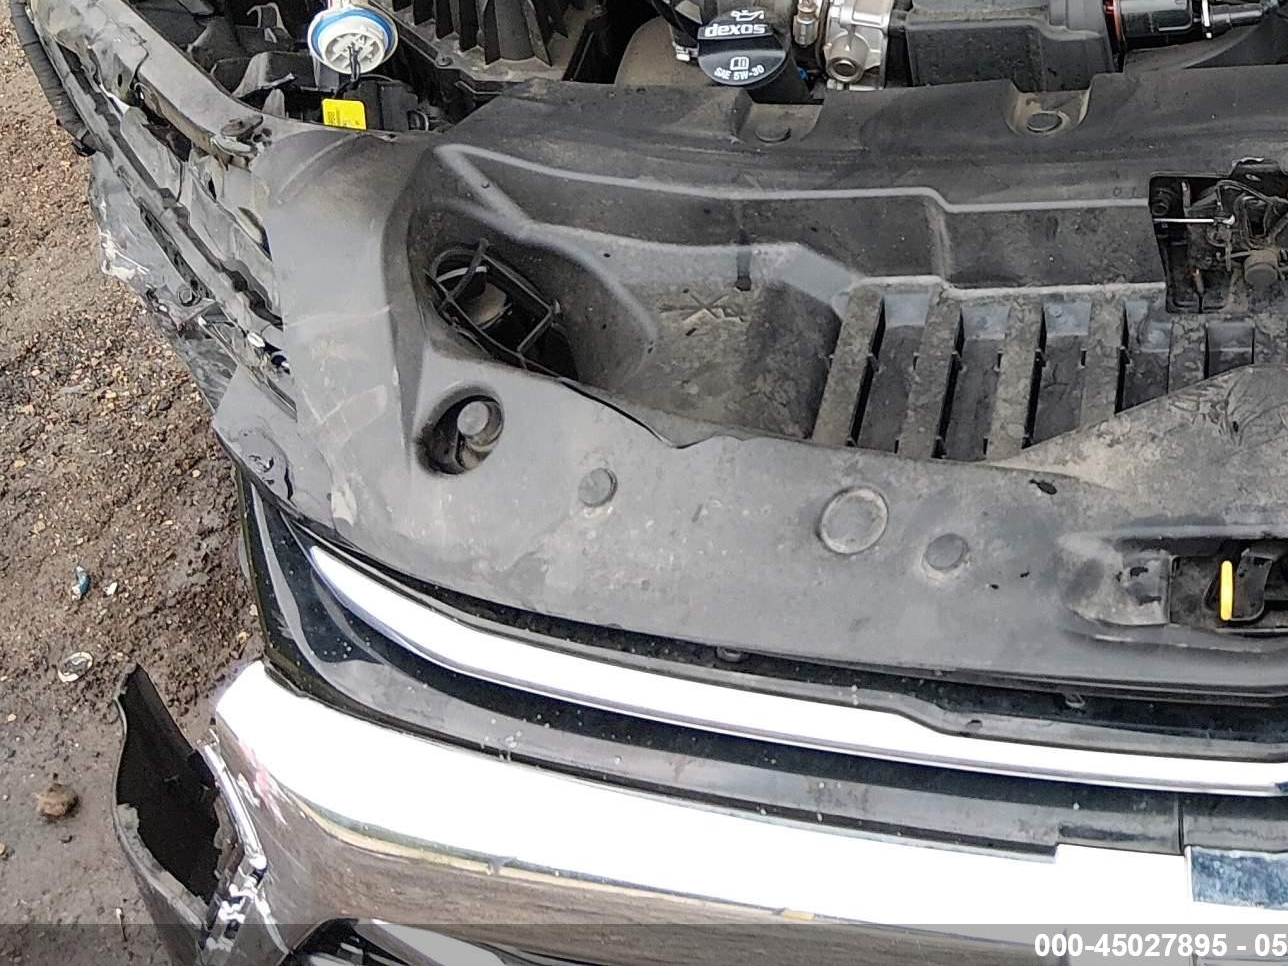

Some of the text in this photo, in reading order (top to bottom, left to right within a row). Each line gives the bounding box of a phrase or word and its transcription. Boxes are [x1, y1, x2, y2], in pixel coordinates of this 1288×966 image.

[705, 23, 768, 37] dexos
[714, 64, 765, 81] SAE 5W-30
